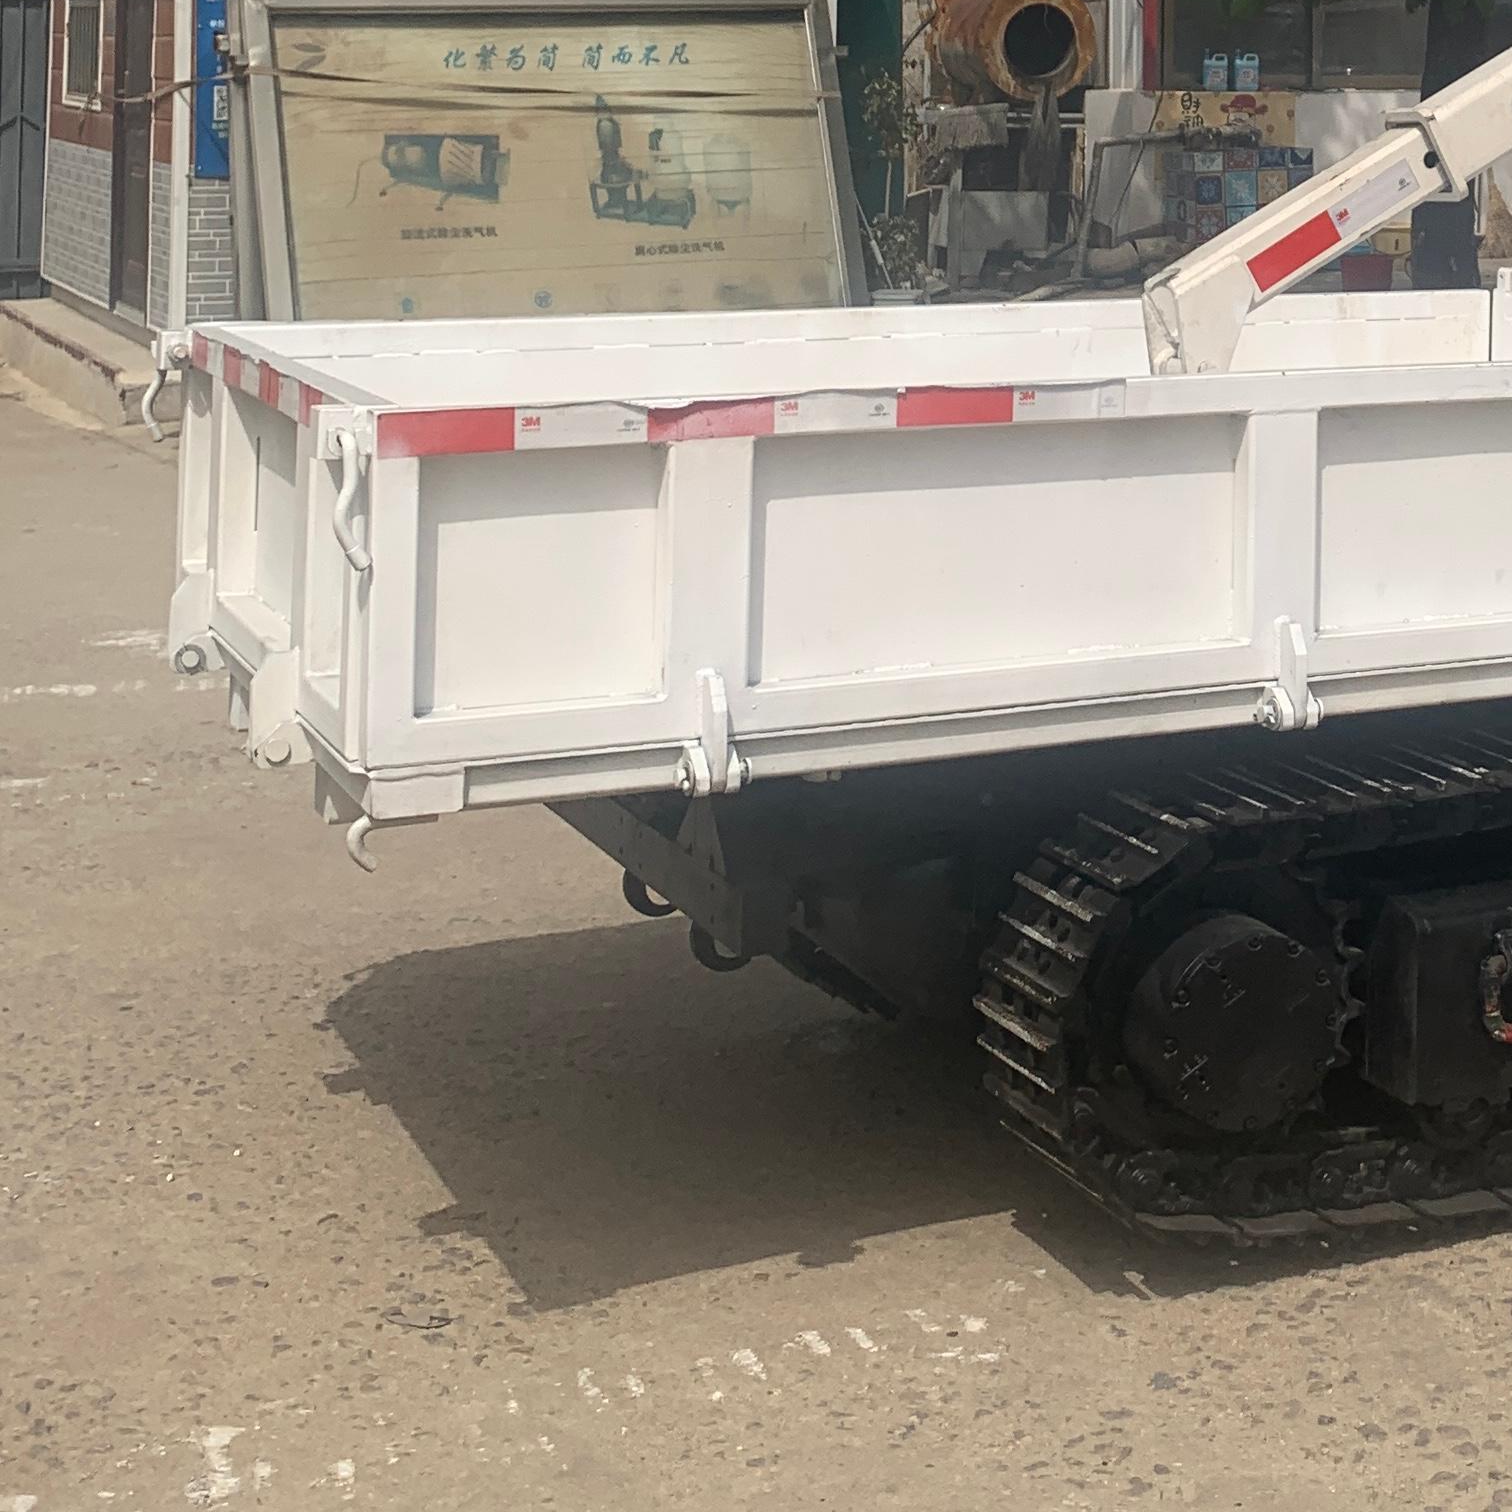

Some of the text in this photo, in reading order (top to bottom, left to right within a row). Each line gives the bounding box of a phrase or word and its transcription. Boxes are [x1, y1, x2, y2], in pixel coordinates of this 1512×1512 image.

[443, 43, 689, 71] 化繁为简 简而不凡
[1336, 208, 1349, 221] 3M
[1019, 391, 1035, 401] 3M
[781, 401, 799, 412] 3M
[521, 416, 541, 427] 3M
